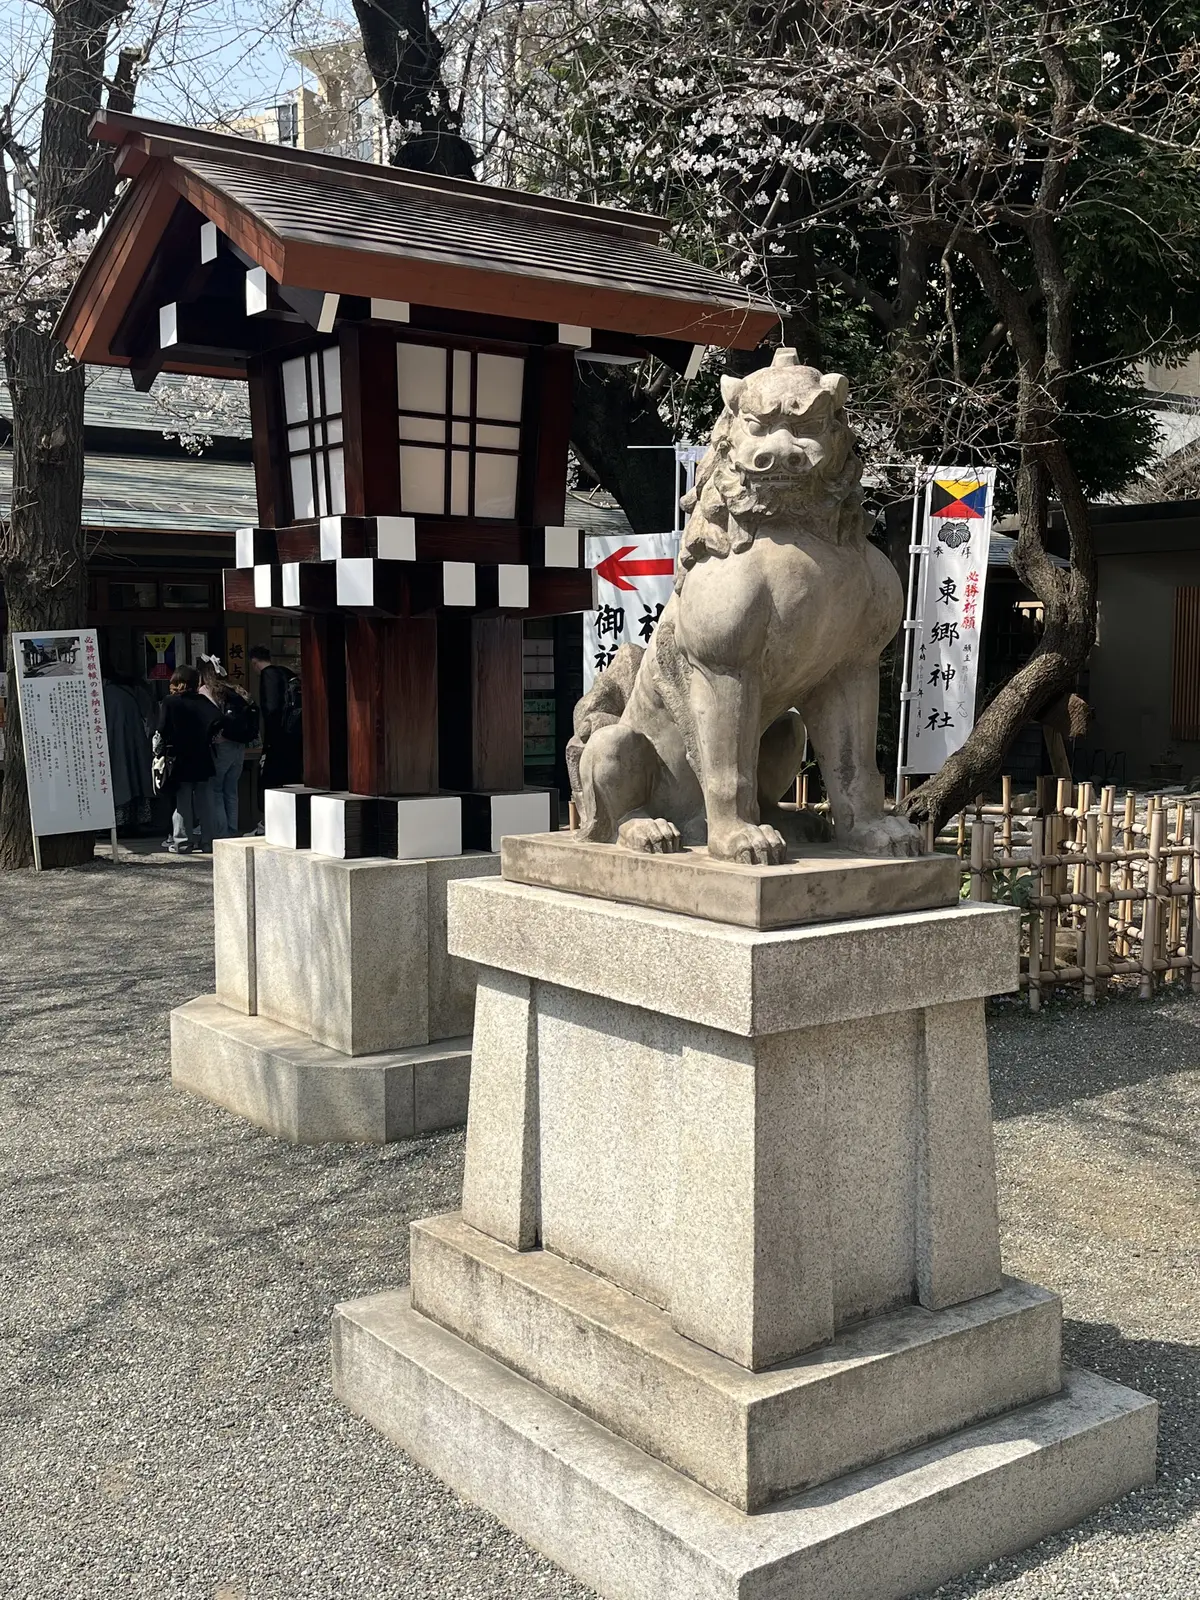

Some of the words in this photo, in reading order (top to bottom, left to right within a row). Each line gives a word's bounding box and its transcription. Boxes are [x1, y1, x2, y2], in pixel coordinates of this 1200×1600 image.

[960, 571, 980, 630] 必勝祈願
[228, 643, 245, 687] 授与
[924, 577, 960, 731] 東郷神社
